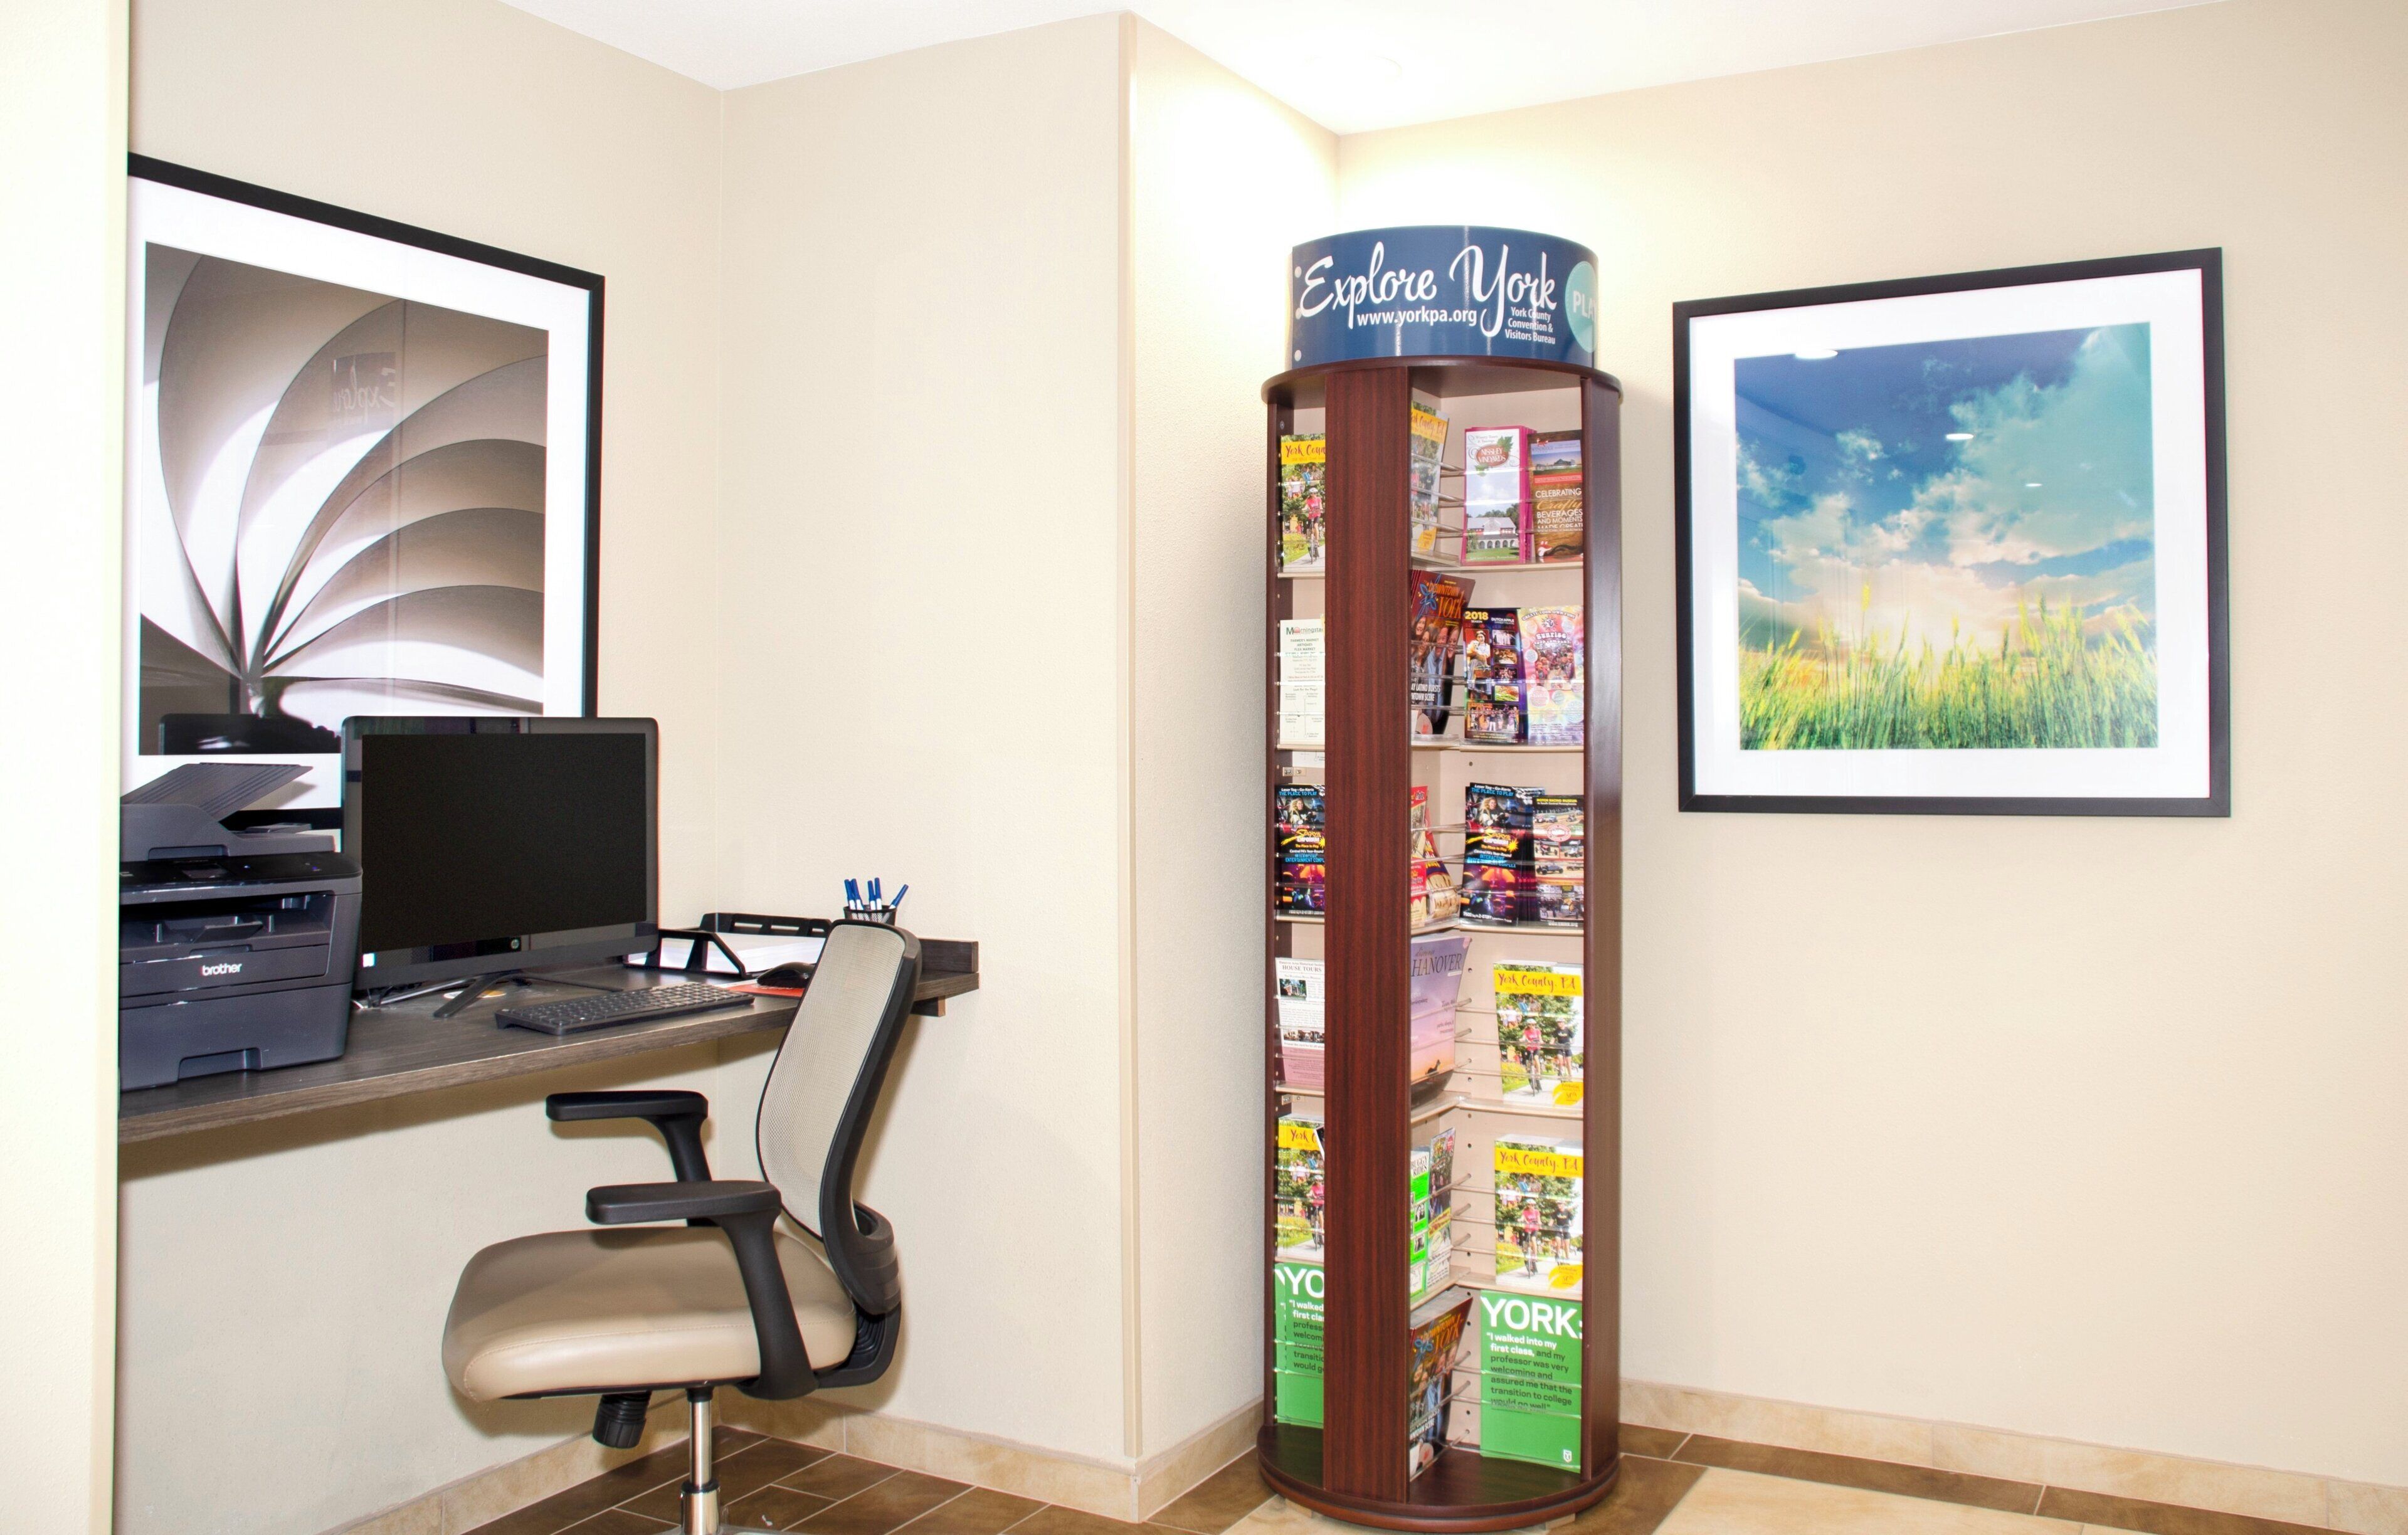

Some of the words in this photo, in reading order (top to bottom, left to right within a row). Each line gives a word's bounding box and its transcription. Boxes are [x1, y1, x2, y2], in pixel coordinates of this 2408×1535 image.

[1300, 241, 1437, 330] Explore
[1449, 243, 1557, 338] York
[1356, 305, 1477, 327] www.yorkpa.org
[1511, 307, 1527, 317] York
[1528, 309, 1551, 324] County
[1508, 318, 1547, 333] Convention
[1548, 324, 1554, 333] &
[1505, 329, 1532, 340] Visitors
[1533, 335, 1556, 344] Bureau
[1286, 444, 1304, 458] York
[1535, 487, 1582, 498] CELEBRATING
[1536, 509, 1583, 519] BEVERAGES
[1428, 583, 1460, 597] DOWNTOWN
[1464, 611, 1489, 620] 2018
[1535, 631, 1567, 640] Sunrise
[202, 963, 243, 976] brother
[1411, 953, 1462, 977] HANOVER
[1497, 973, 1519, 986] York
[1561, 977, 1576, 990] PA
[1291, 1129, 1309, 1144] York
[1411, 1155, 1427, 1170] BUGGY
[1500, 1151, 1521, 1166] York
[1563, 1157, 1578, 1171] PA
[1413, 1164, 1427, 1177] RIDES
[1296, 1301, 1324, 1312] walked
[1292, 1309, 1310, 1320] first
[1293, 1321, 1324, 1331] profess
[1494, 1333, 1525, 1344] walked
[1526, 1336, 1544, 1347] into
[1544, 1340, 1557, 1351] my
[1490, 1342, 1509, 1353] first
[1510, 1345, 1535, 1358] class,
[1536, 1349, 1552, 1359] and
[1553, 1353, 1566, 1363] my
[1293, 1361, 1316, 1371] would
[1318, 1366, 1324, 1374] g
[1491, 1354, 1532, 1366] professor
[1533, 1361, 1550, 1369] was
[1551, 1363, 1569, 1373] very
[1491, 1365, 1536, 1378] welcoming
[1538, 1371, 1553, 1380] and
[1491, 1377, 1524, 1387] assured
[1539, 1381, 1558, 1392] that
[1559, 1385, 1573, 1395] the
[1491, 1386, 1532, 1398] transition
[1533, 1391, 1542, 1400] to
[1543, 1394, 1573, 1406] college
